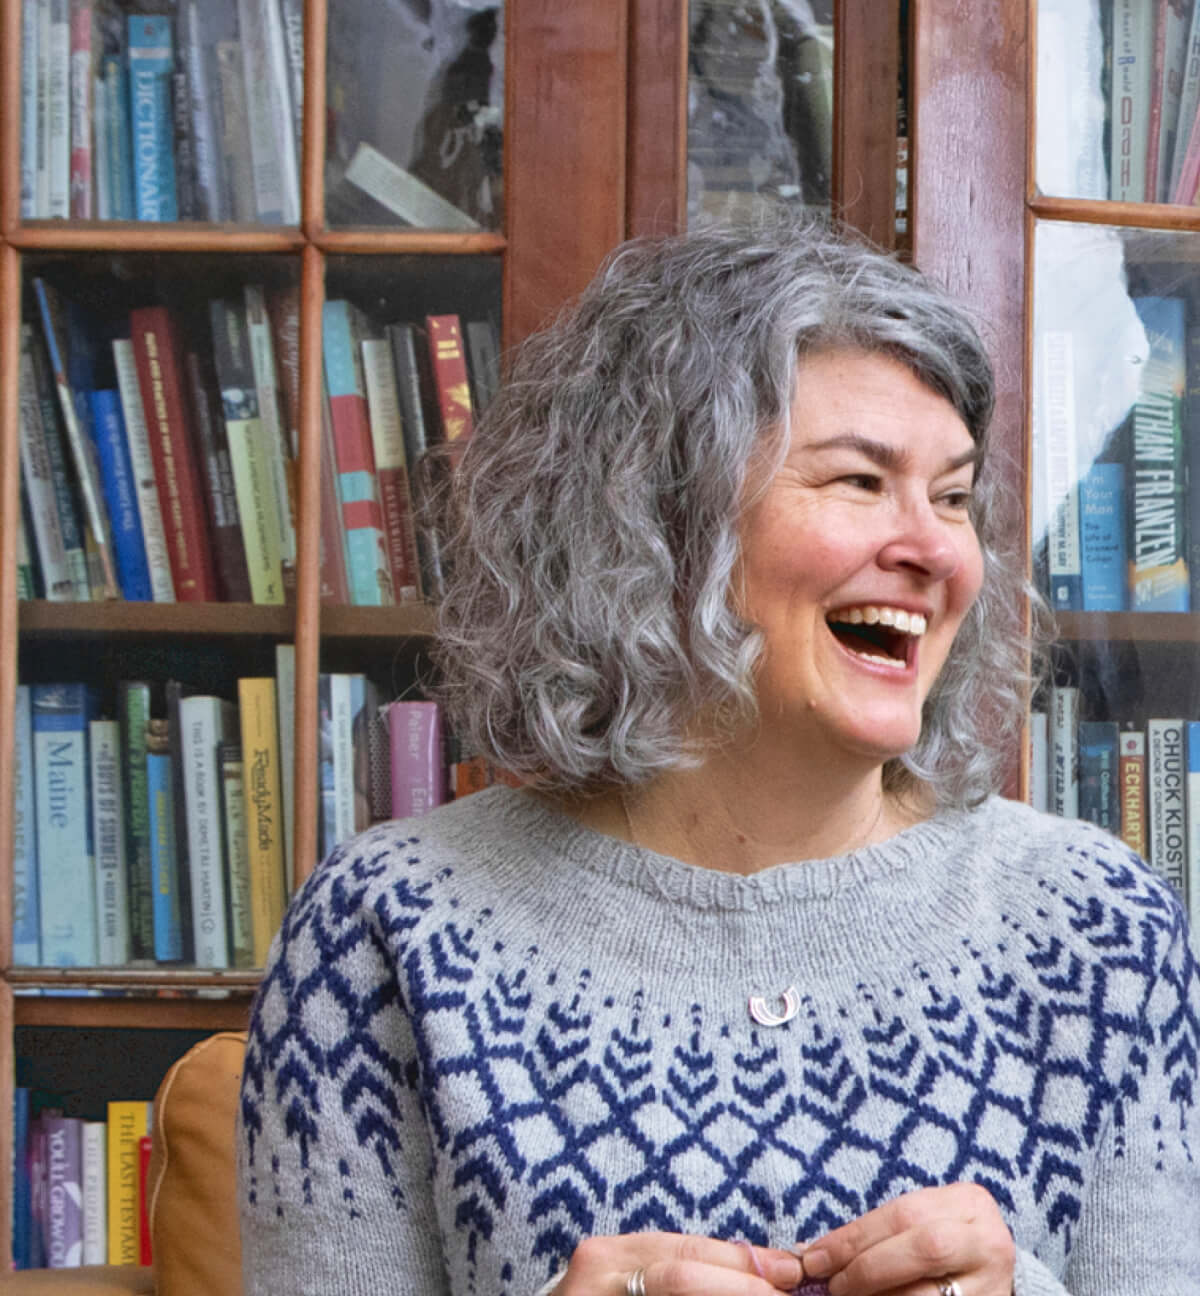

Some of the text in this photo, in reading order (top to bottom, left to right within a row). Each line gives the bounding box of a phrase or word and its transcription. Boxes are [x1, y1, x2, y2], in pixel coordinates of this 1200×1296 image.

[1085, 504, 1114, 515] Man
[1086, 489, 1113, 500] Your
[1135, 468, 1174, 572] FRANZEN
[192, 721, 205, 744] THIS
[193, 747, 205, 758] IS
[194, 760, 205, 771] A
[1164, 729, 1183, 803] CHUCK
[46, 740, 76, 830] Maine
[195, 772, 206, 799] BOOK
[252, 748, 273, 851] ReadyMade
[1152, 729, 1164, 868] A DECADE OF CURIOUS PEOPLE
[99, 798, 117, 813] OF
[196, 802, 207, 816] BY
[1125, 762, 1141, 849] ECKHART
[99, 818, 118, 870] SUMMER
[199, 869, 212, 912] MARTIN
[120, 1112, 138, 1146] THE
[120, 1151, 138, 1188] LAST
[49, 1184, 68, 1239] GROW
